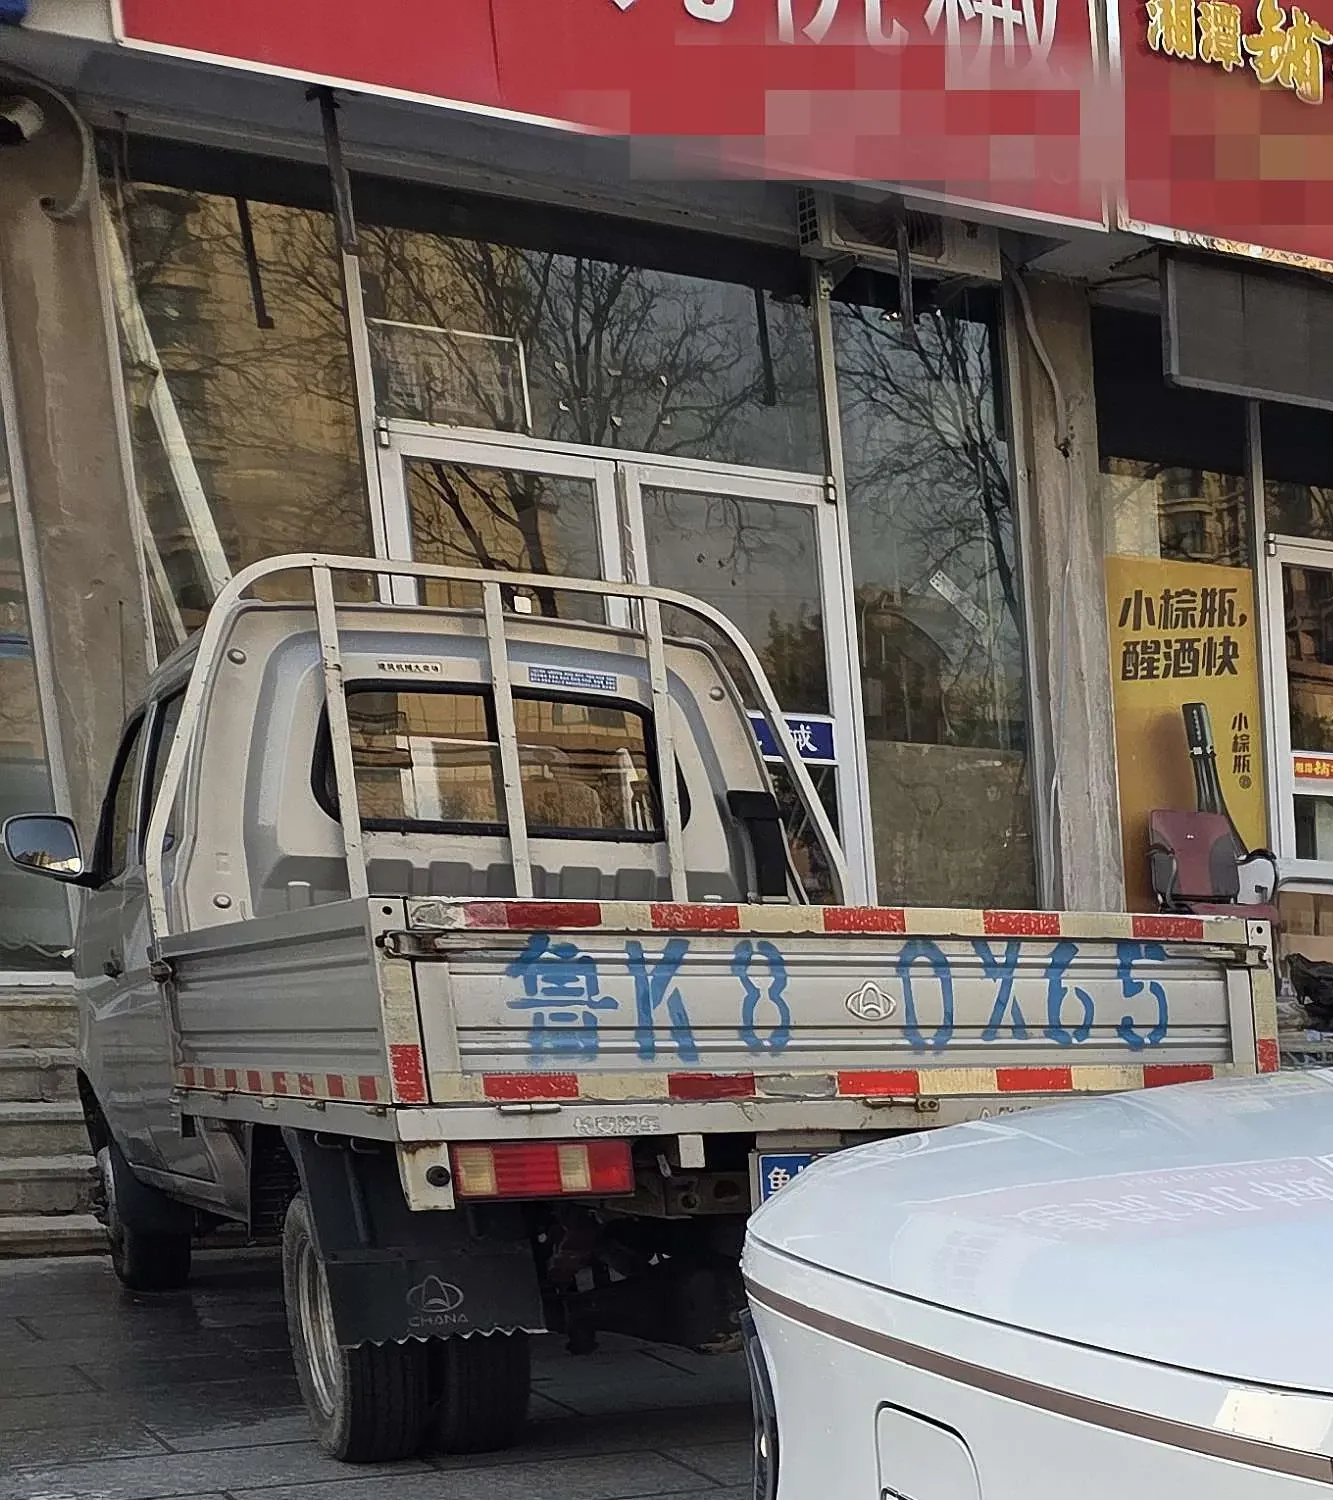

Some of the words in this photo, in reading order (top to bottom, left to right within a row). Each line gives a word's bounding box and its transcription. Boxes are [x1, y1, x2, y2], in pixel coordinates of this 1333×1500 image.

[1121, 635, 1241, 681] 醒酒快
[1231, 711, 1252, 774] 小棕瓶
[408, 1313, 469, 1328] CHANA
